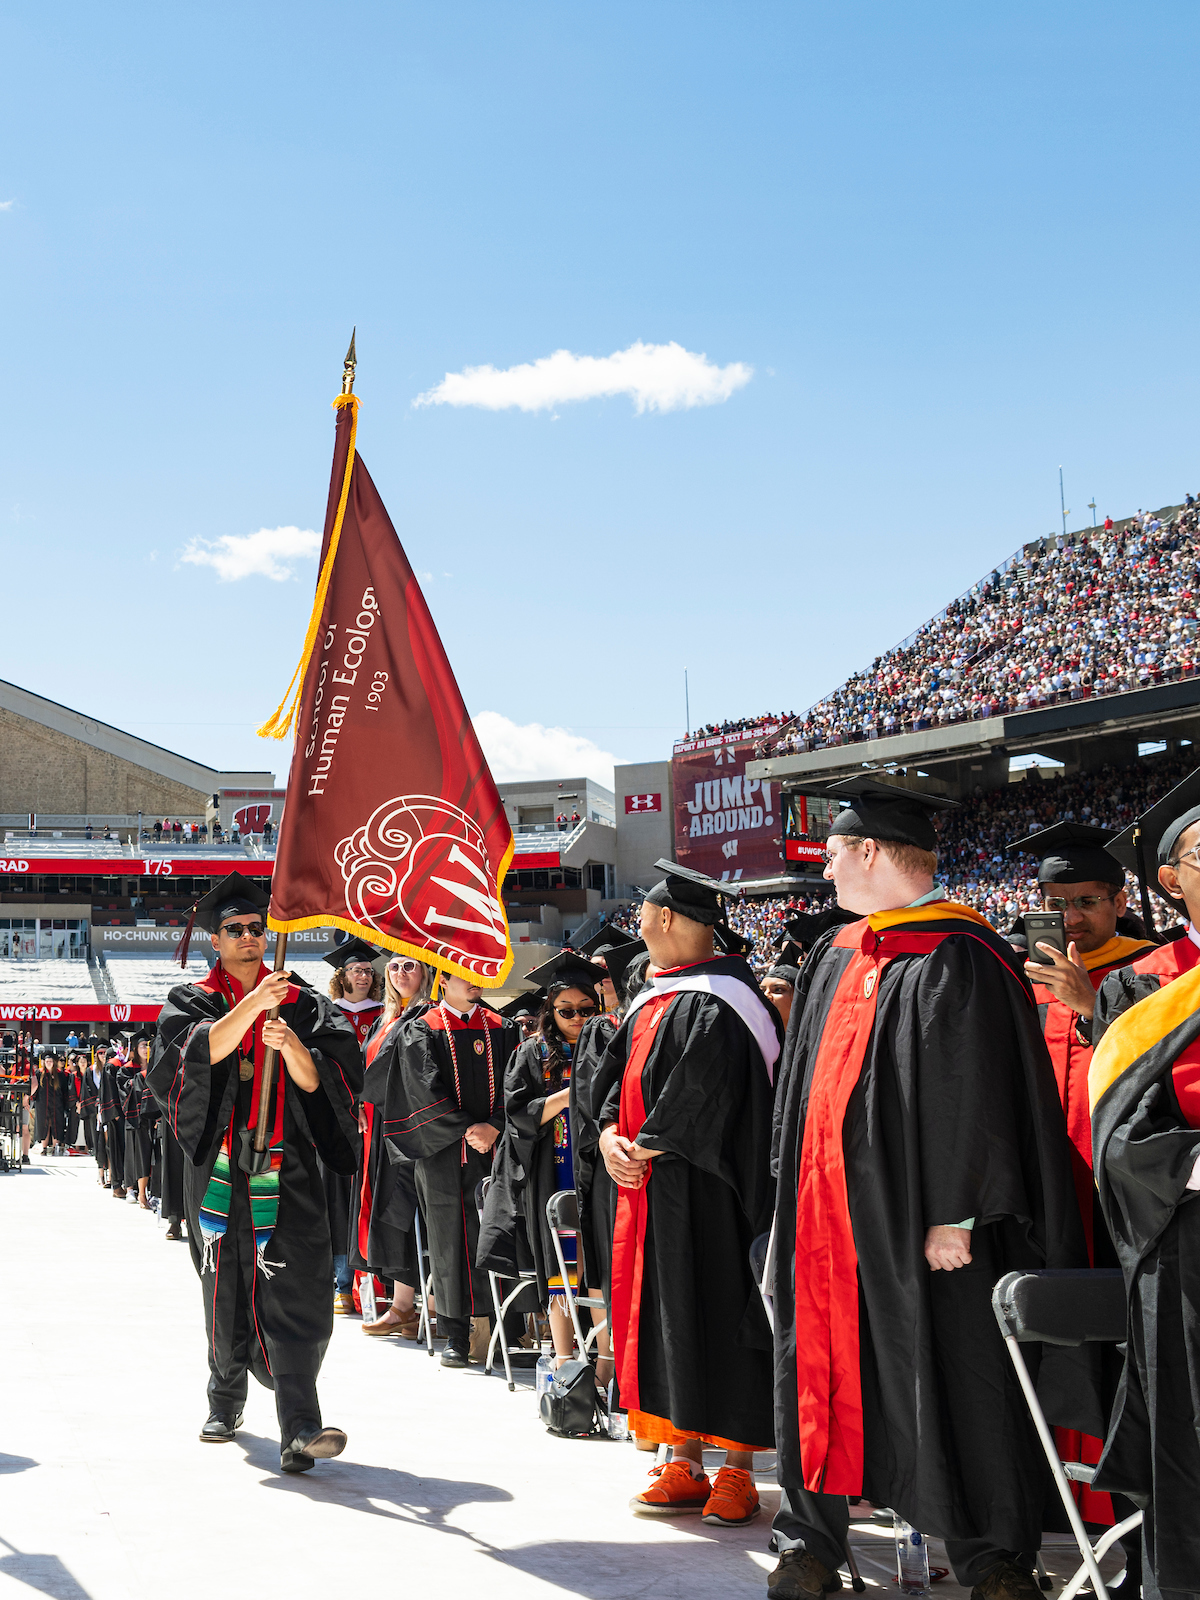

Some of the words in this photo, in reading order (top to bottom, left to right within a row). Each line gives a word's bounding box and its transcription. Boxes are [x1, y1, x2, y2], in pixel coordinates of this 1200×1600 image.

[308, 695, 350, 796] Human
[332, 586, 381, 686] Ecolog
[364, 670, 389, 711] 1903
[687, 774, 761, 814] JUMP
[232, 803, 273, 838] W
[142, 859, 173, 876] 175
[798, 846, 829, 857] #UWGR
[103, 930, 169, 942] HO-CHUNK
[171, 931, 212, 942] GMIN
[294, 931, 329, 943] DELLS
